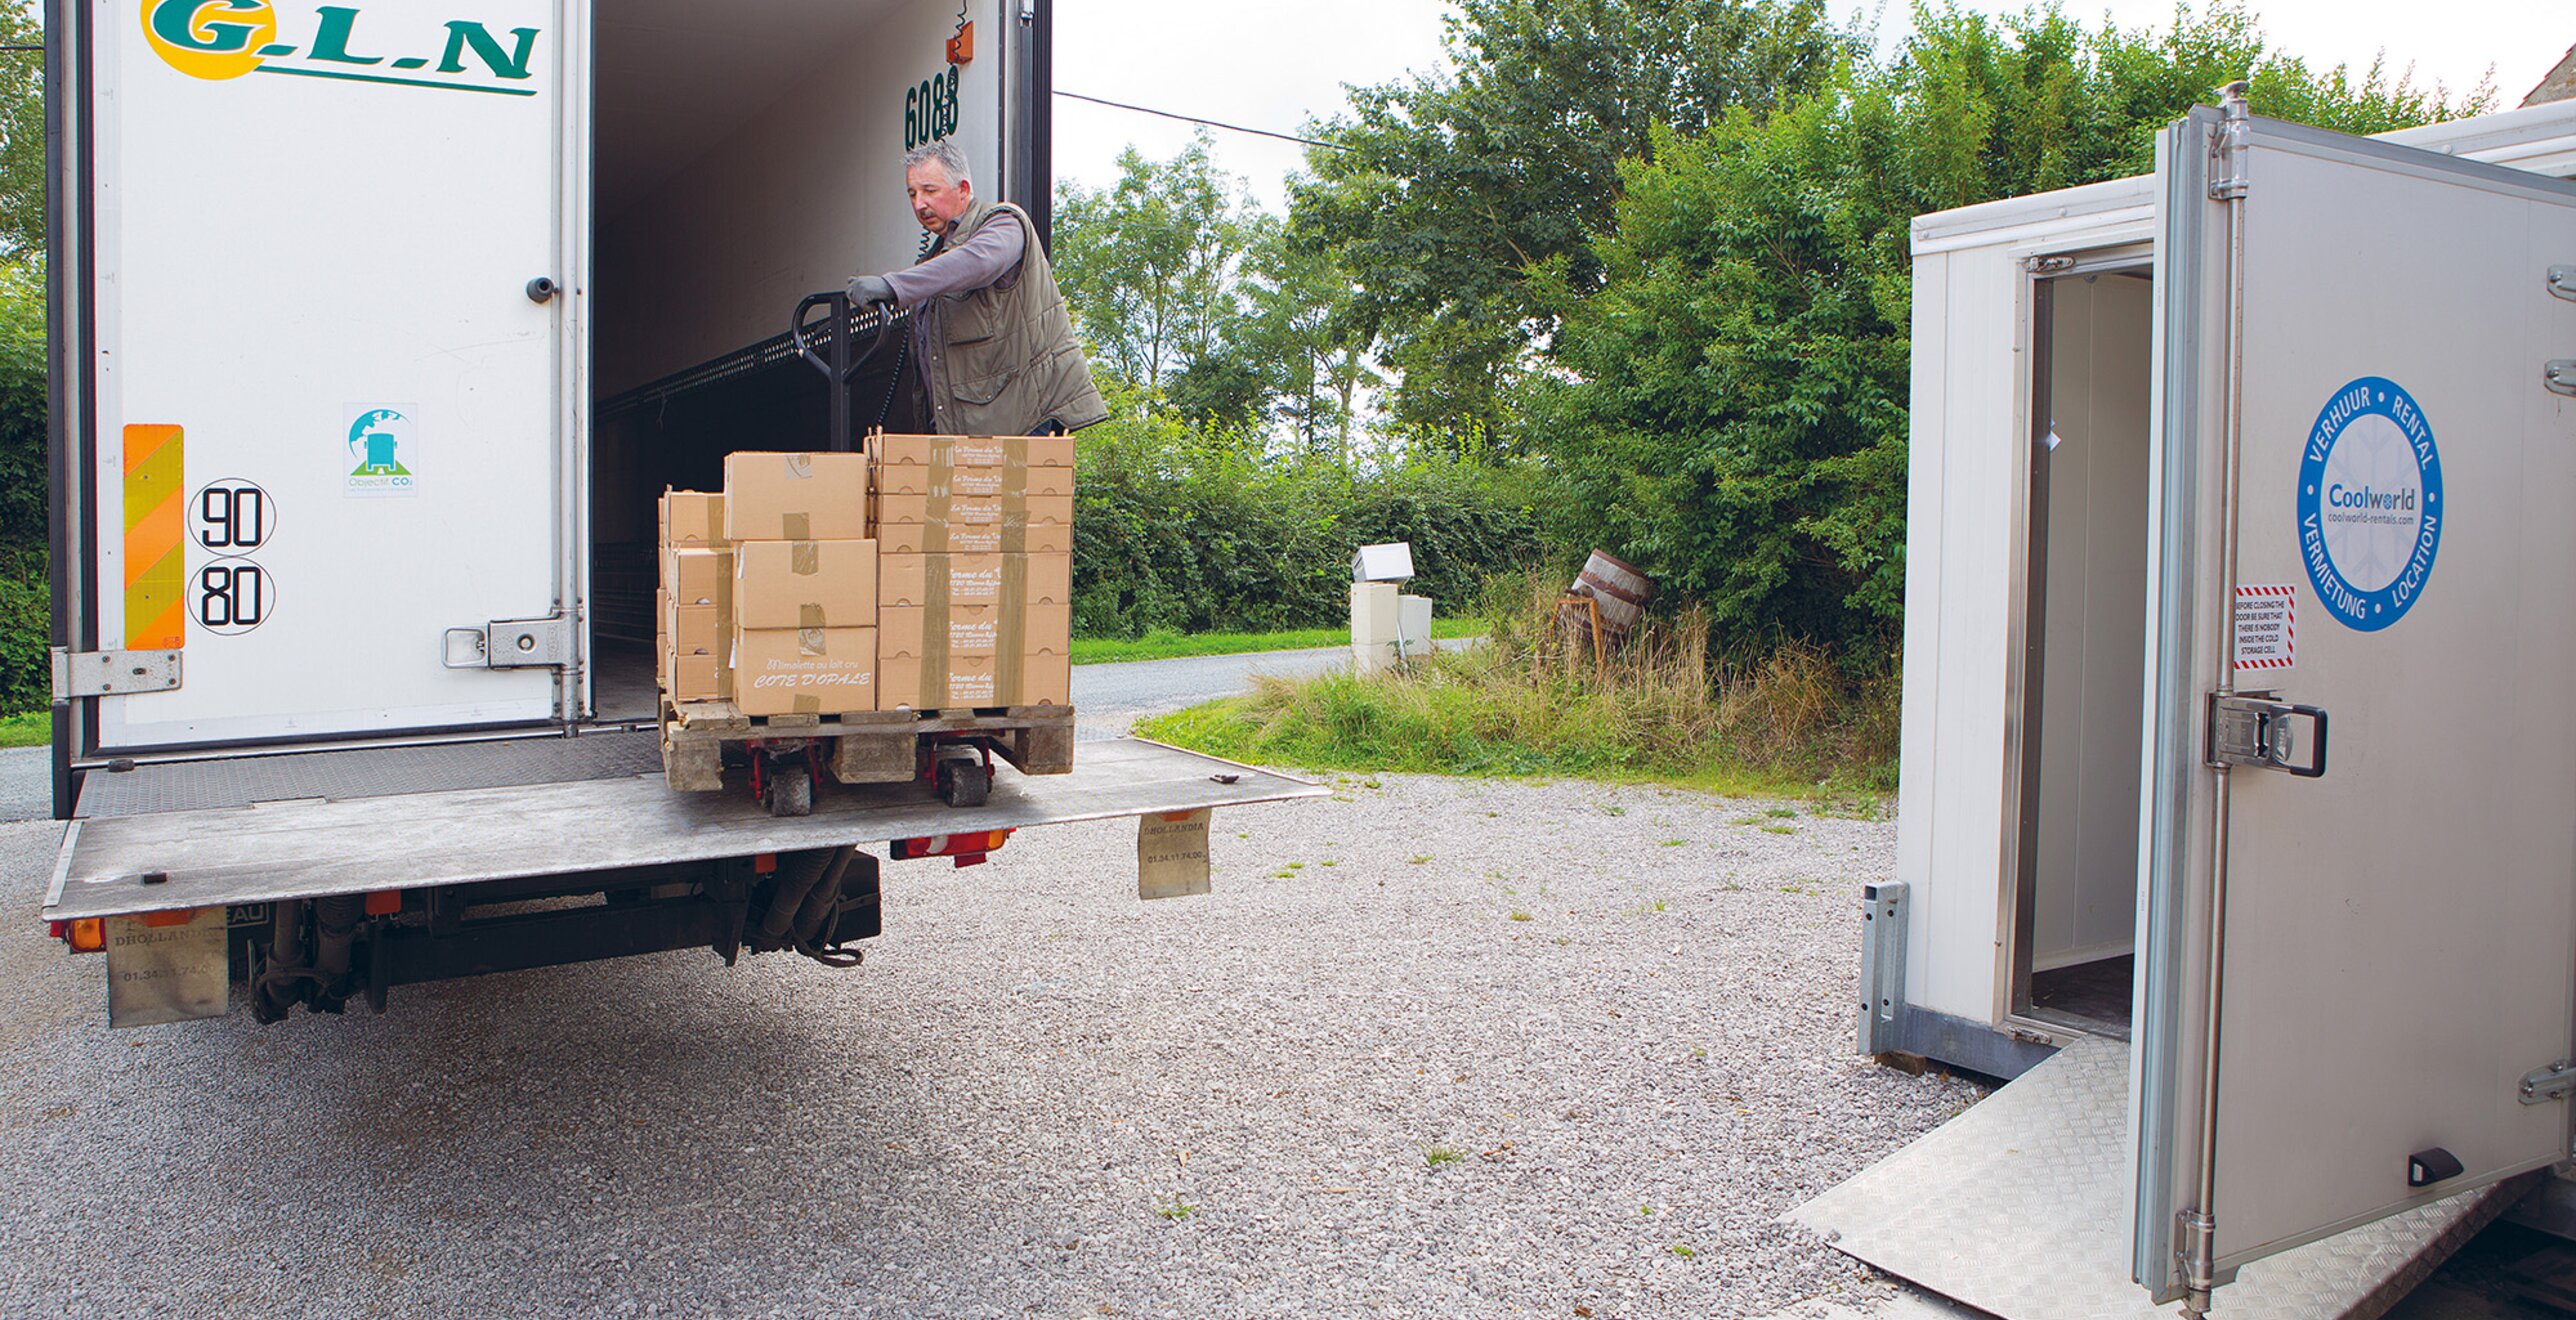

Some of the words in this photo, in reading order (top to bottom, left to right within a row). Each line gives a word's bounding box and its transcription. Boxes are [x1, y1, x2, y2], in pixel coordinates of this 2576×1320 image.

[905, 65, 959, 153] 6088
[2309, 386, 2371, 463] VERHUUR
[2391, 394, 2434, 471] RENTAL
[202, 487, 262, 547] 90
[2328, 512, 2414, 525] coolworld-rentals.com
[2329, 483, 2415, 511] Coolworld
[2303, 512, 2366, 619] VERMIETUNG
[2391, 515, 2437, 608] LOCATION
[202, 566, 261, 626] 80
[753, 673, 798, 689] COTE
[766, 658, 815, 671] Mimolette
